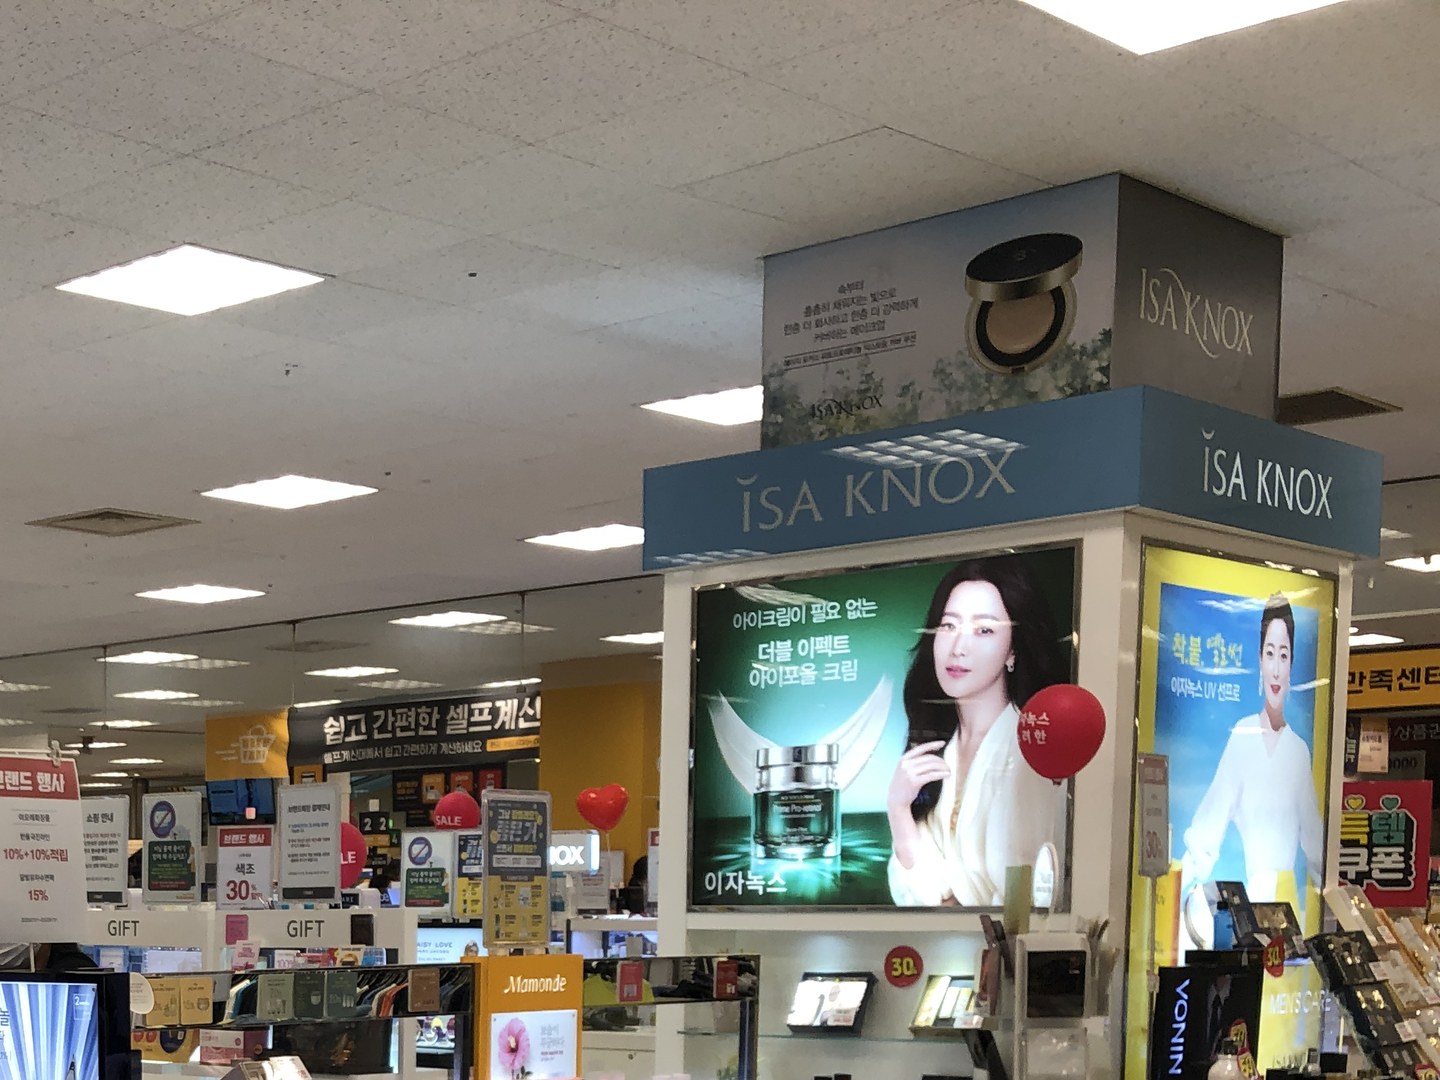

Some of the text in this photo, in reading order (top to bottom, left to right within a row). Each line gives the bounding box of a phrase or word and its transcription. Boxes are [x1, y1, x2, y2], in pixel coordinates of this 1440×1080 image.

[1140, 267, 1253, 357] ISA KNOX
[810, 395, 883, 419] ISA KNOX
[845, 448, 1018, 518] KNOX
[1256, 459, 1335, 520] KNOX
[733, 598, 879, 631] 아이크림이 필요 없는
[758, 634, 852, 663] 더블 이펙트
[749, 660, 859, 690] 아이포올 크림
[1170, 676, 1203, 699] 이자녹스
[1204, 681, 1217, 699] UV
[323, 714, 367, 746] 쉽고
[372, 705, 440, 741] 간편한
[1020, 711, 1050, 727] 자녹스
[384, 745, 402, 758] 쉽고
[403, 742, 438, 757] 간편하게
[439, 740, 483, 754] 계산하세요
[36, 769, 66, 793] 행사
[435, 815, 462, 827] SALE
[223, 833, 265, 844] 브랜드 행사
[3, 848, 69, 863] 10%+10%적립
[340, 850, 357, 865] LE
[235, 863, 256, 876] 색조
[226, 879, 250, 900] 30
[704, 871, 788, 896] 이자녹스
[28, 889, 49, 902] 15%
[107, 920, 140, 938] GIFT
[287, 919, 325, 938] GIFT
[417, 941, 453, 949] AISY LOVE
[503, 974, 567, 994] Mamonde
[1169, 978, 1191, 1075] VONIN
